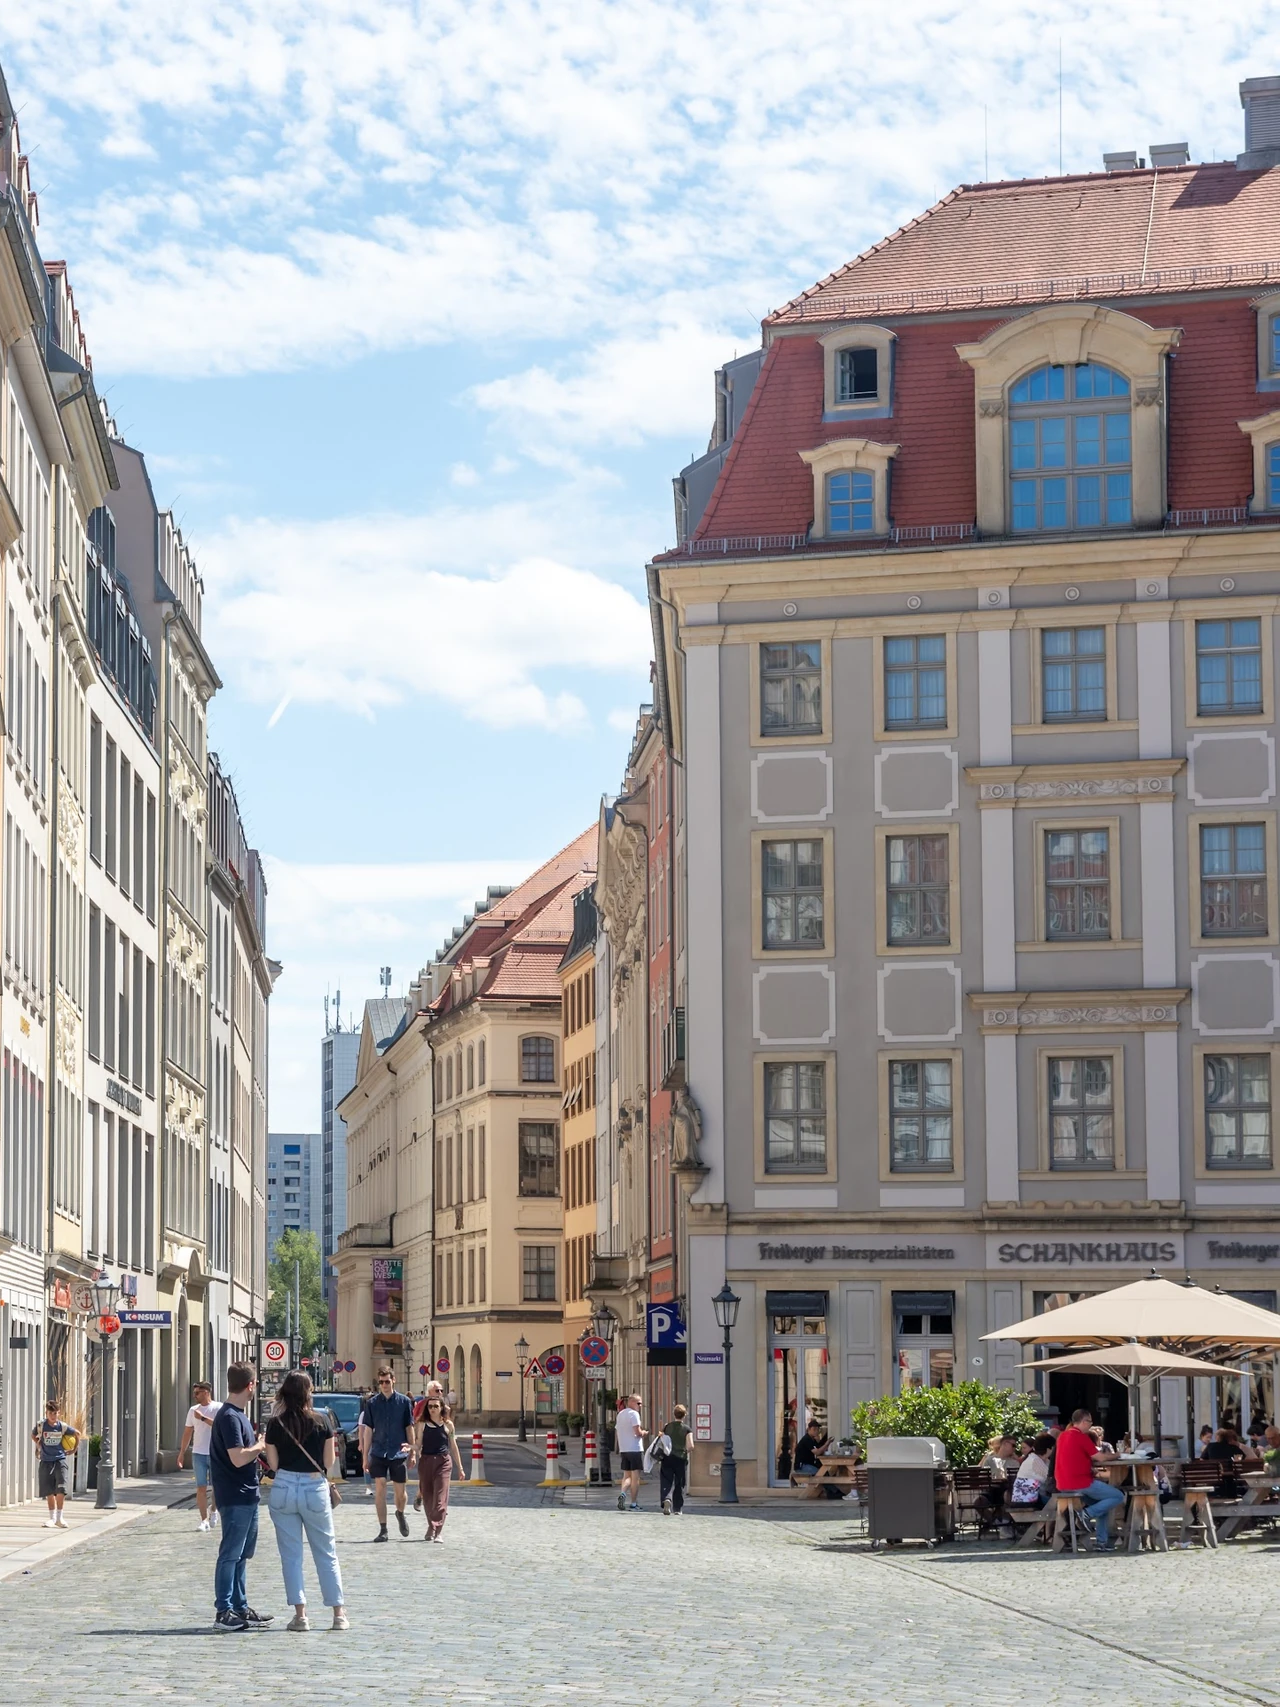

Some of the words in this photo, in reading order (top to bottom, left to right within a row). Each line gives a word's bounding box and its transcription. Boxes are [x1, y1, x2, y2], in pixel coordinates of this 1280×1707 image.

[758, 1243, 826, 1263] Freiberger
[832, 1245, 955, 1263] Bierspezialitäten
[998, 1242, 1176, 1265] SCHANKHAUS
[1207, 1241, 1280, 1262] Freiberger
[125, 1313, 164, 1321] KONSUM
[651, 1312, 671, 1343] P
[269, 1346, 281, 1356] 30
